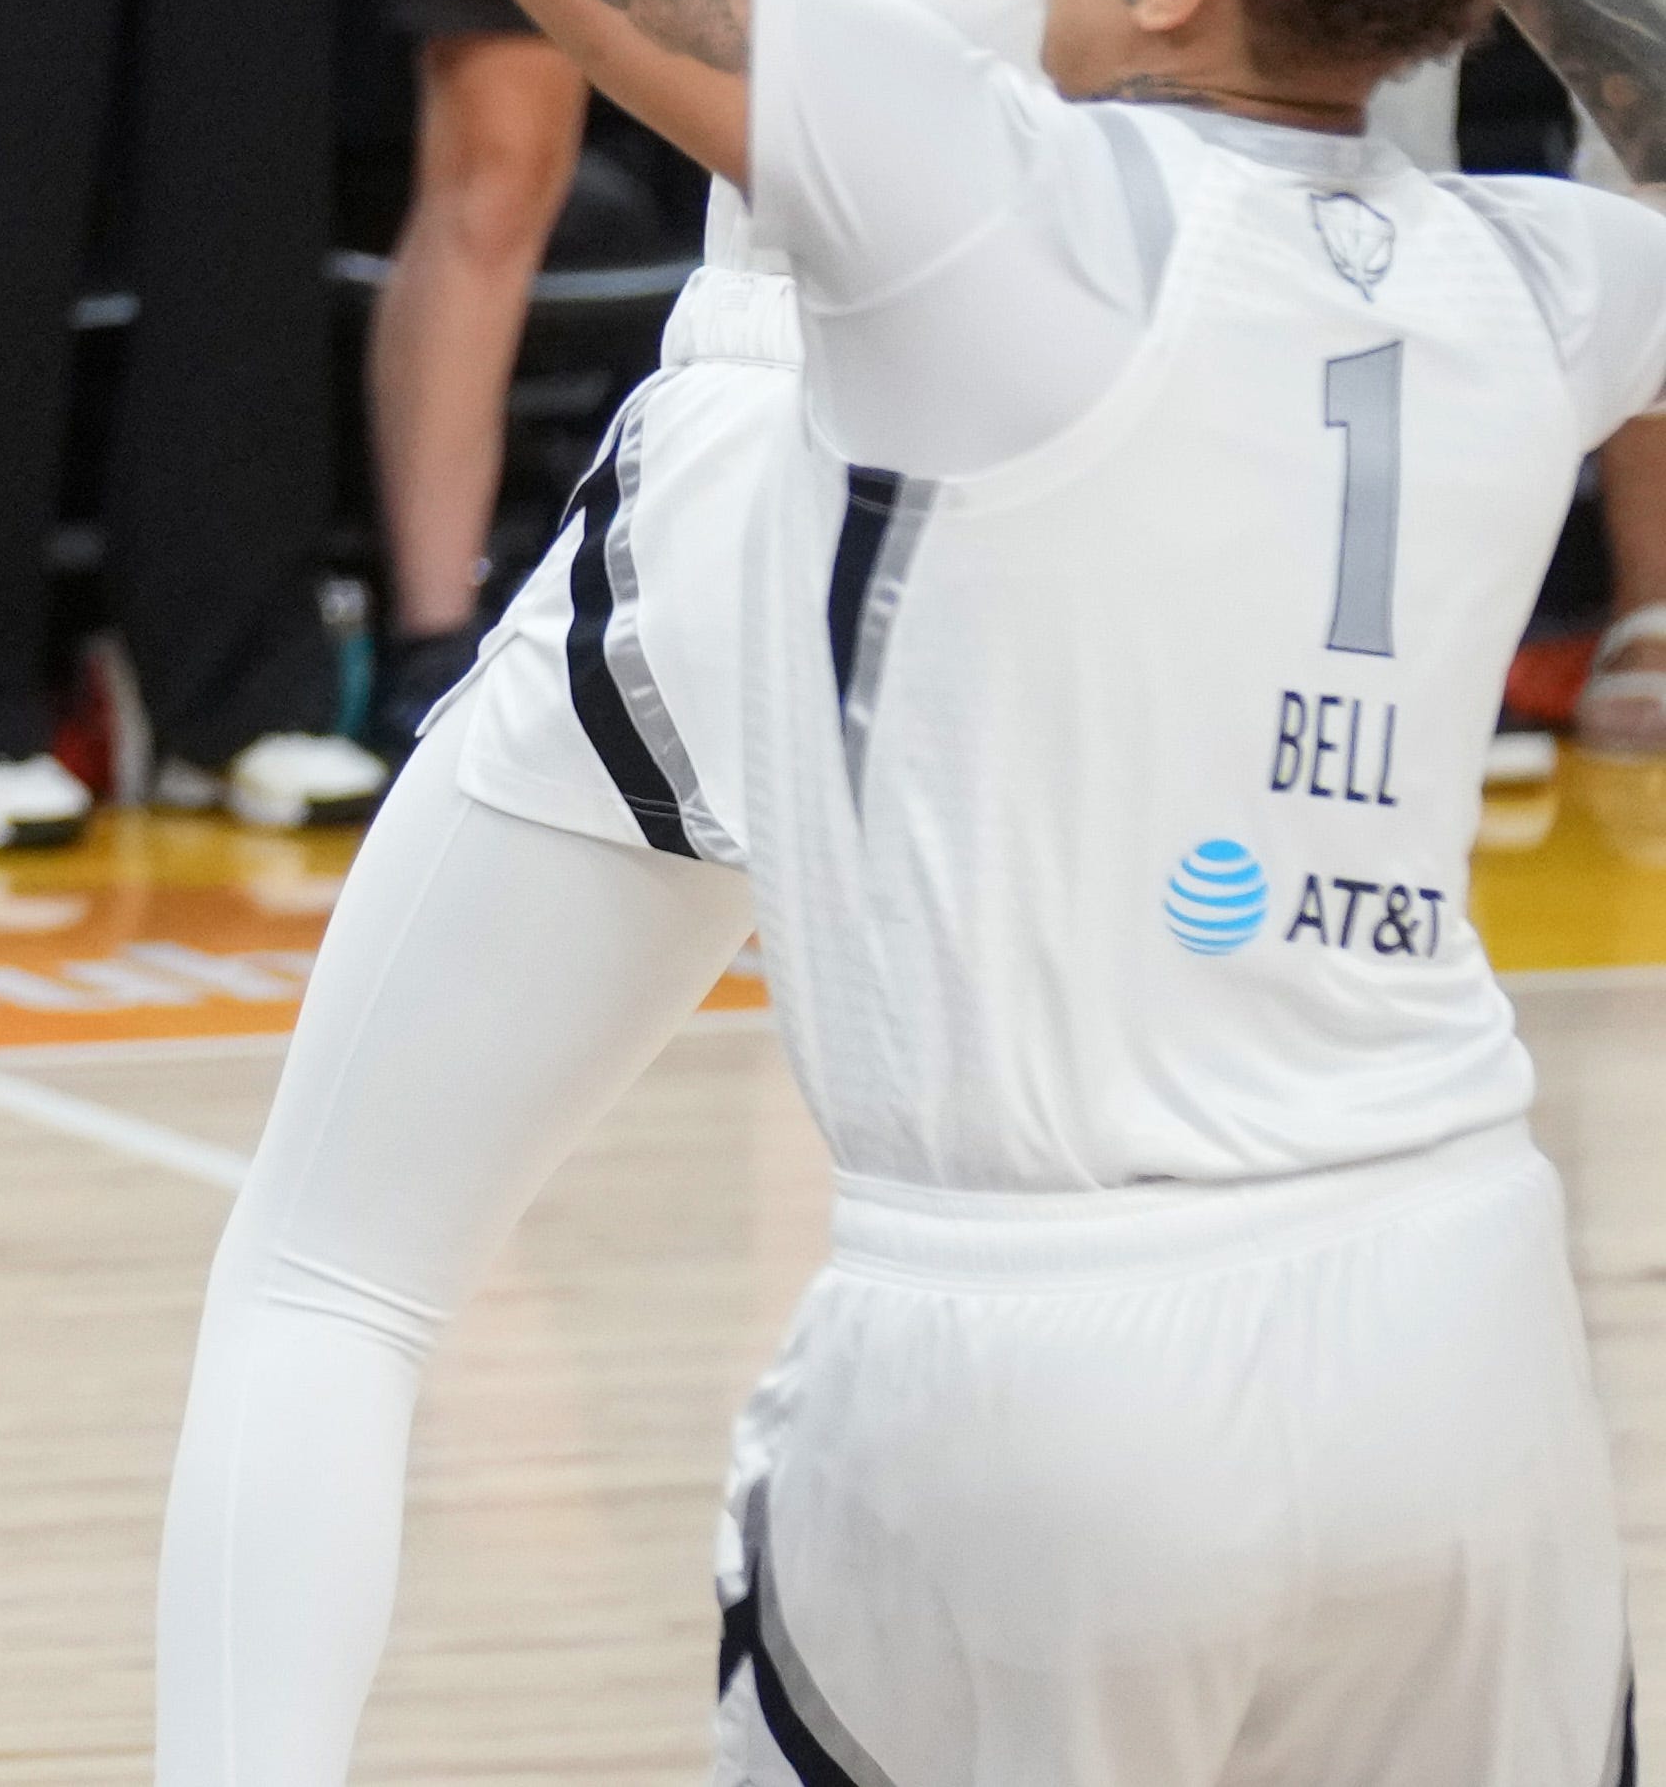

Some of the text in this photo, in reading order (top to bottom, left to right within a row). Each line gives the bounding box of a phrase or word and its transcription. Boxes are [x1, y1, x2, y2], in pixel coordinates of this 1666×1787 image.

[1324, 341, 1404, 657] 1
[1269, 690, 1399, 807] BELL
[1284, 873, 1445, 958] AT&T
